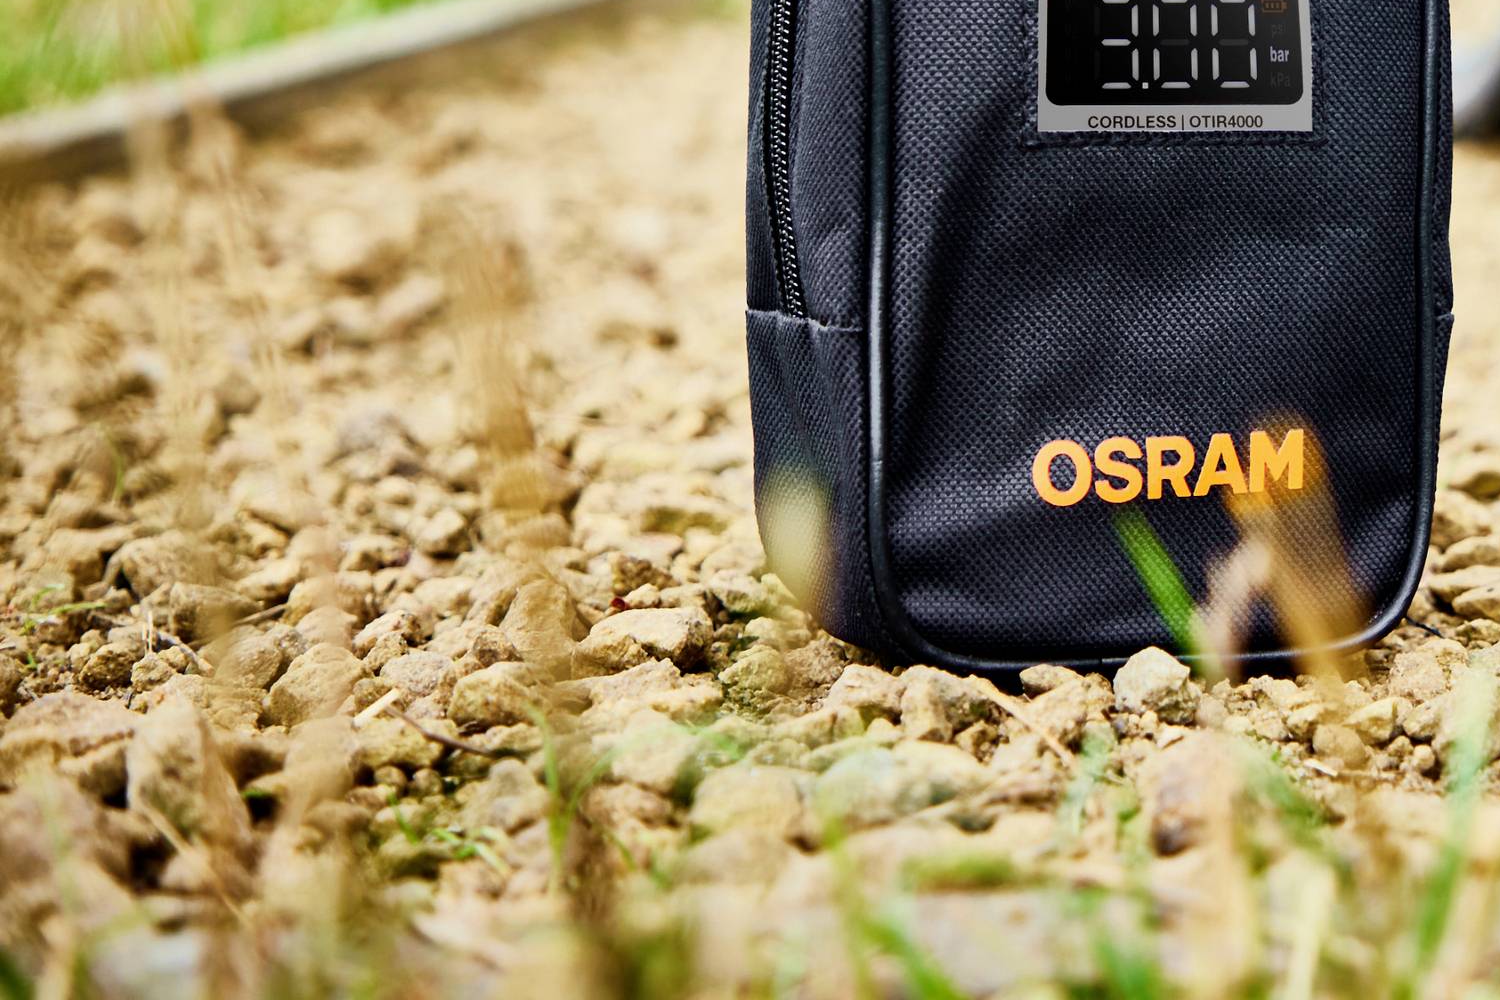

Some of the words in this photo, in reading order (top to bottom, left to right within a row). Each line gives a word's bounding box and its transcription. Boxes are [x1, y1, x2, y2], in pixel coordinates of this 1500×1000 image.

[1269, 45, 1290, 62] bar
[1087, 115, 1177, 129] CORDLESS
[1189, 114, 1264, 129] OTIR4000
[1031, 428, 1305, 507] OSRAM
